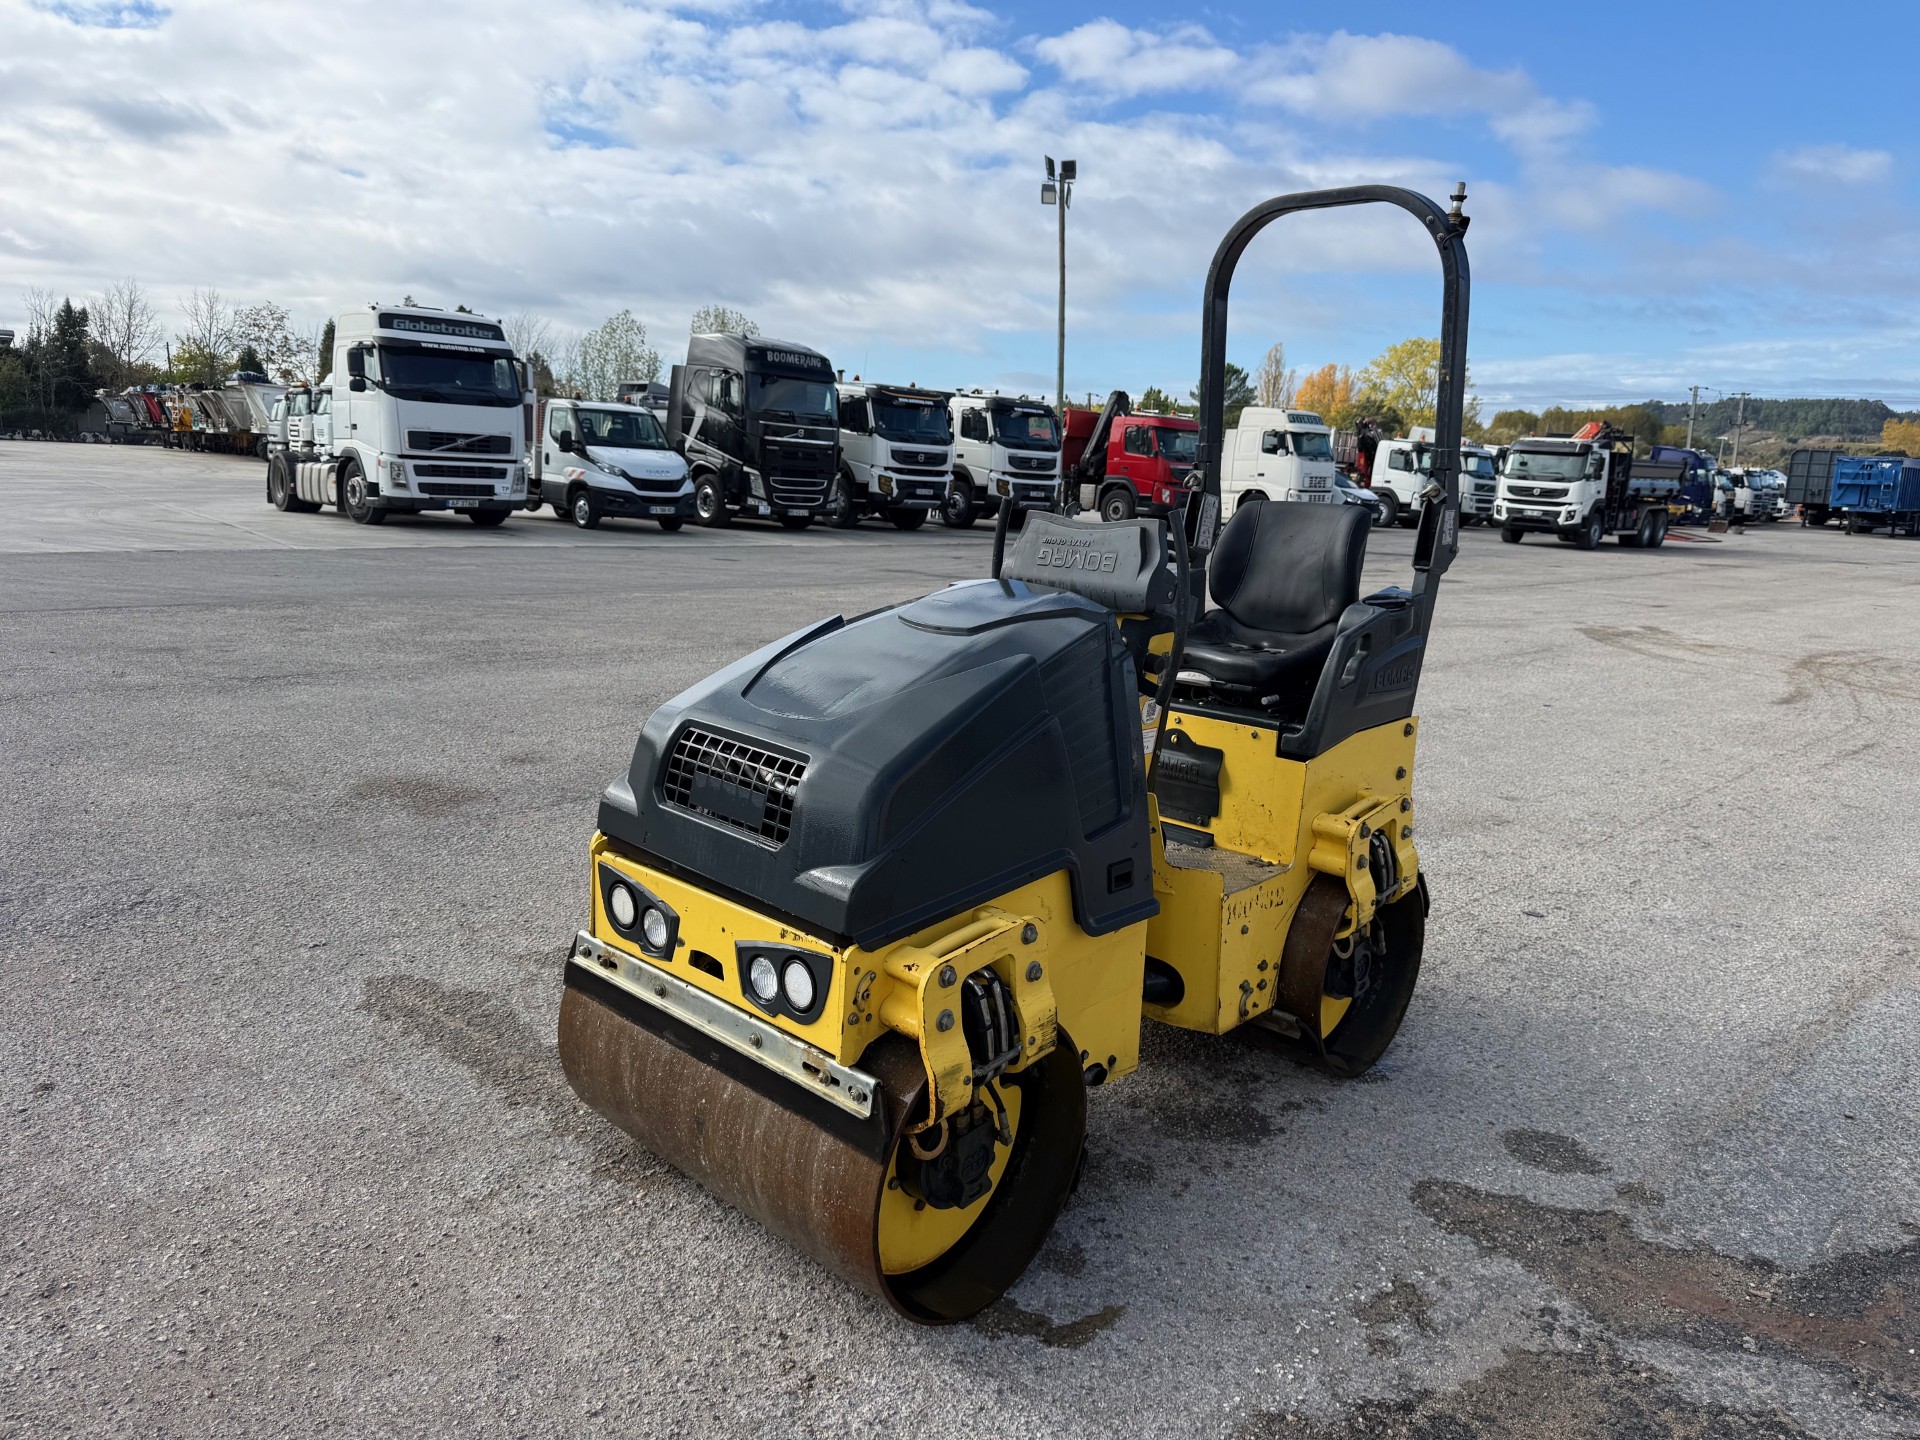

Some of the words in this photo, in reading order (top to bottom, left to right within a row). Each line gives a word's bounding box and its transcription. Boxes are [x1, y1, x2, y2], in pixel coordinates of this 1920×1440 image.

[393, 319, 495, 338] Globetrotter
[767, 351, 821, 368] BOOMERANG
[1037, 547, 1118, 573] BOMAG
